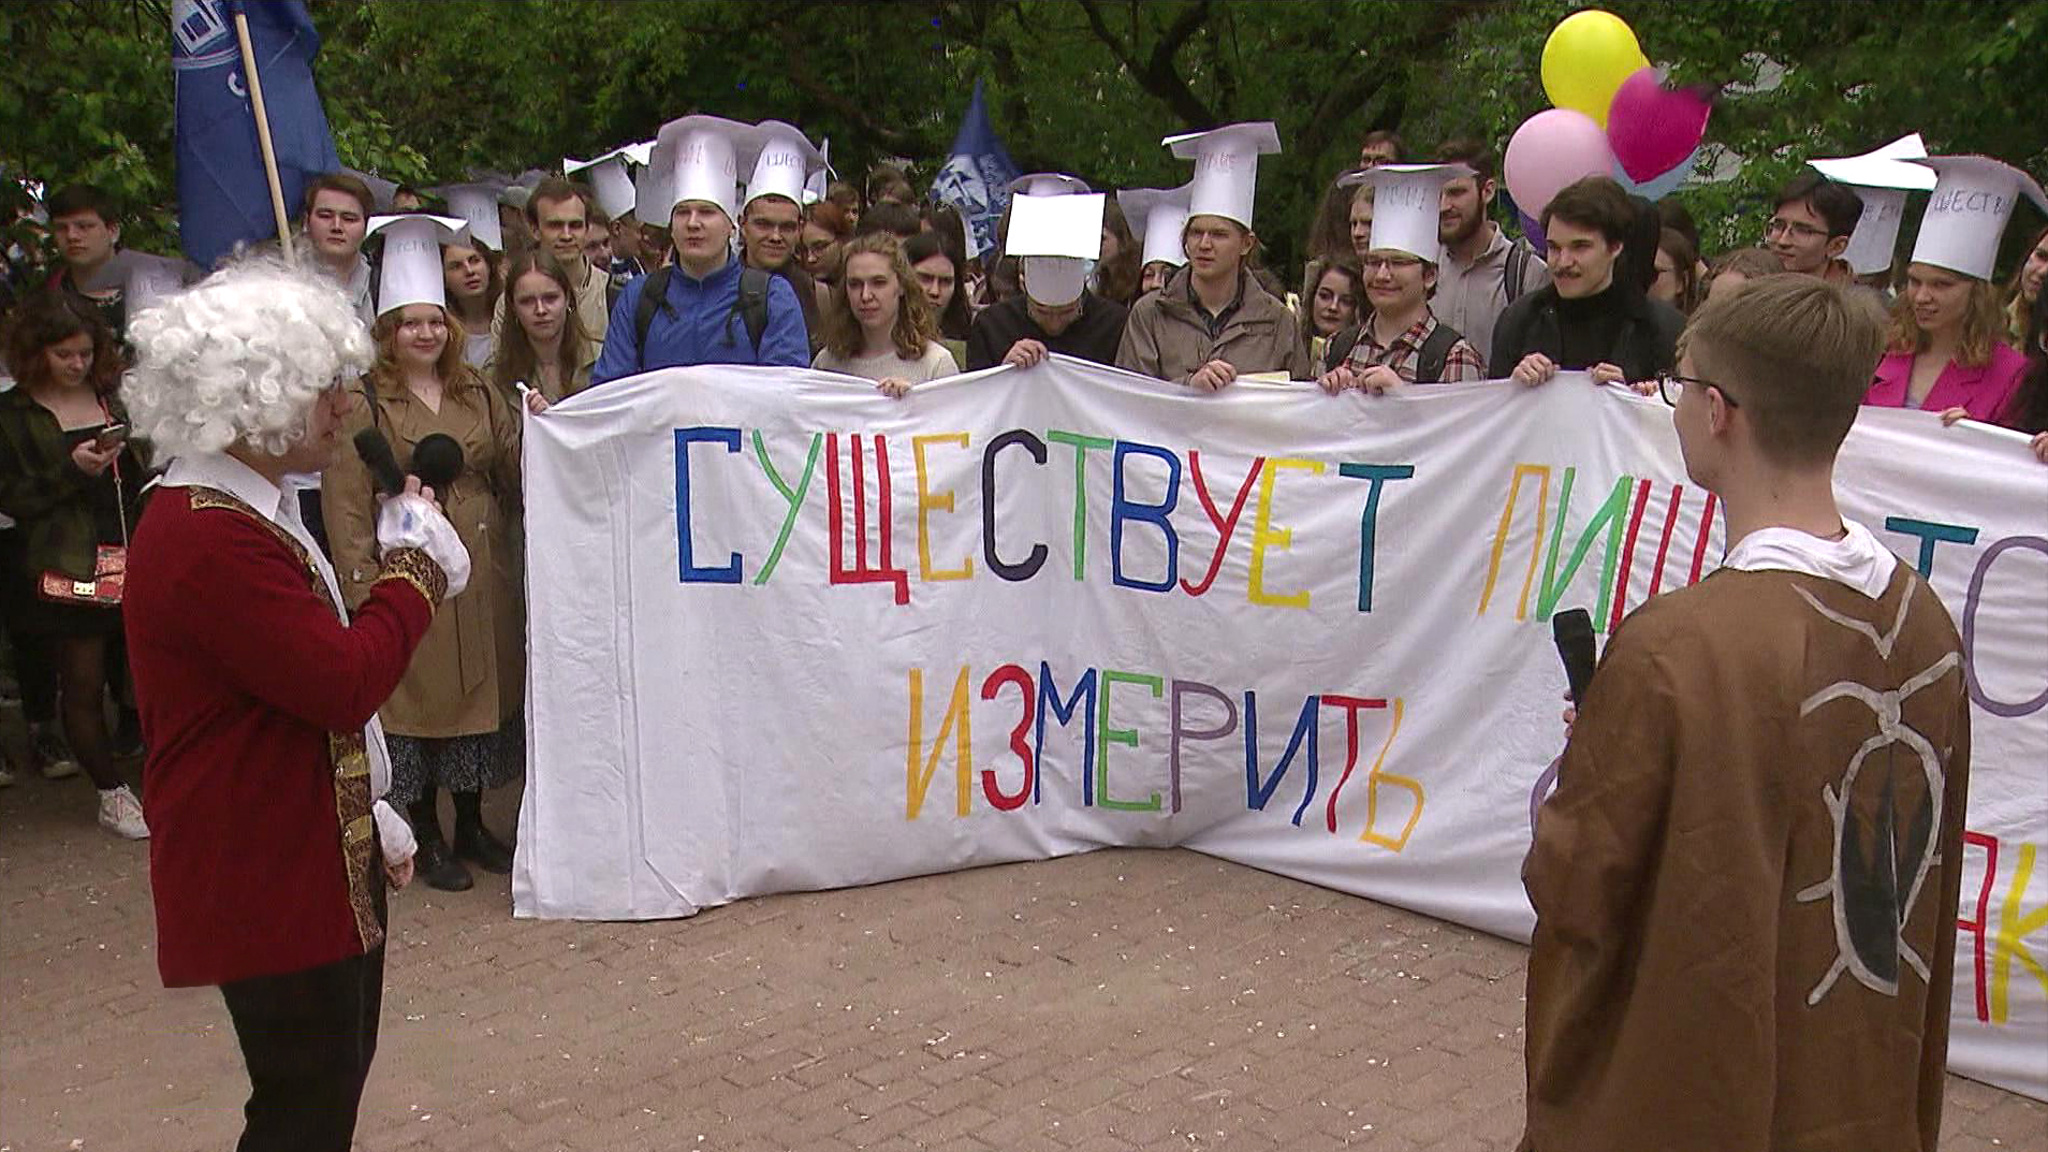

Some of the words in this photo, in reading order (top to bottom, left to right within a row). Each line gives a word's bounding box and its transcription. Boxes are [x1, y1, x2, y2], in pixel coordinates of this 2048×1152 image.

[674, 427, 1415, 612] СУЩЕСТВУЕТ
[1477, 463, 1717, 635] ЛИШ
[906, 660, 1425, 852] ИЗМЕРИТЬ
